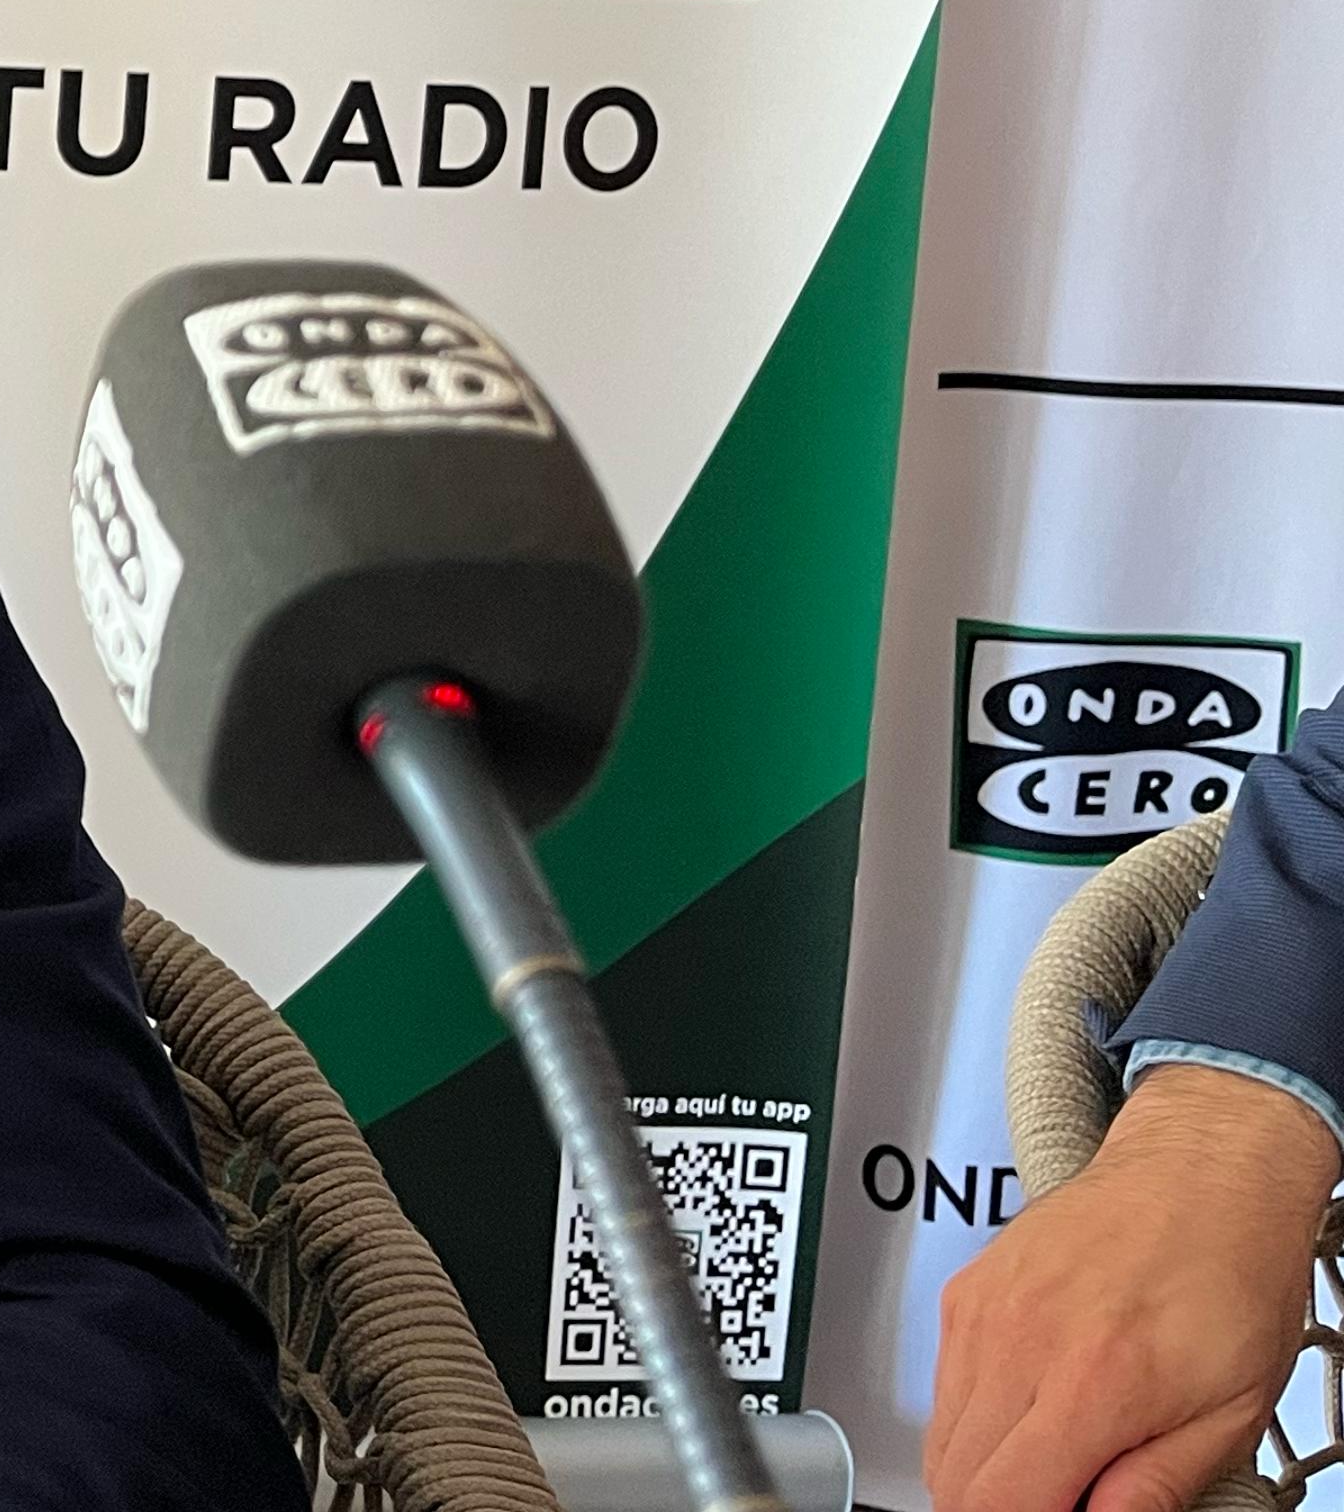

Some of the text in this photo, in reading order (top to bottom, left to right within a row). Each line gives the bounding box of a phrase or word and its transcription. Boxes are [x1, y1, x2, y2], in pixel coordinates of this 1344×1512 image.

[206, 75, 659, 191] RADIO
[1008, 683, 1232, 729] ONDA
[1018, 768, 1229, 816] CERO
[623, 1093, 811, 1124] arga aquí tu app
[863, 1144, 1024, 1226] OND
